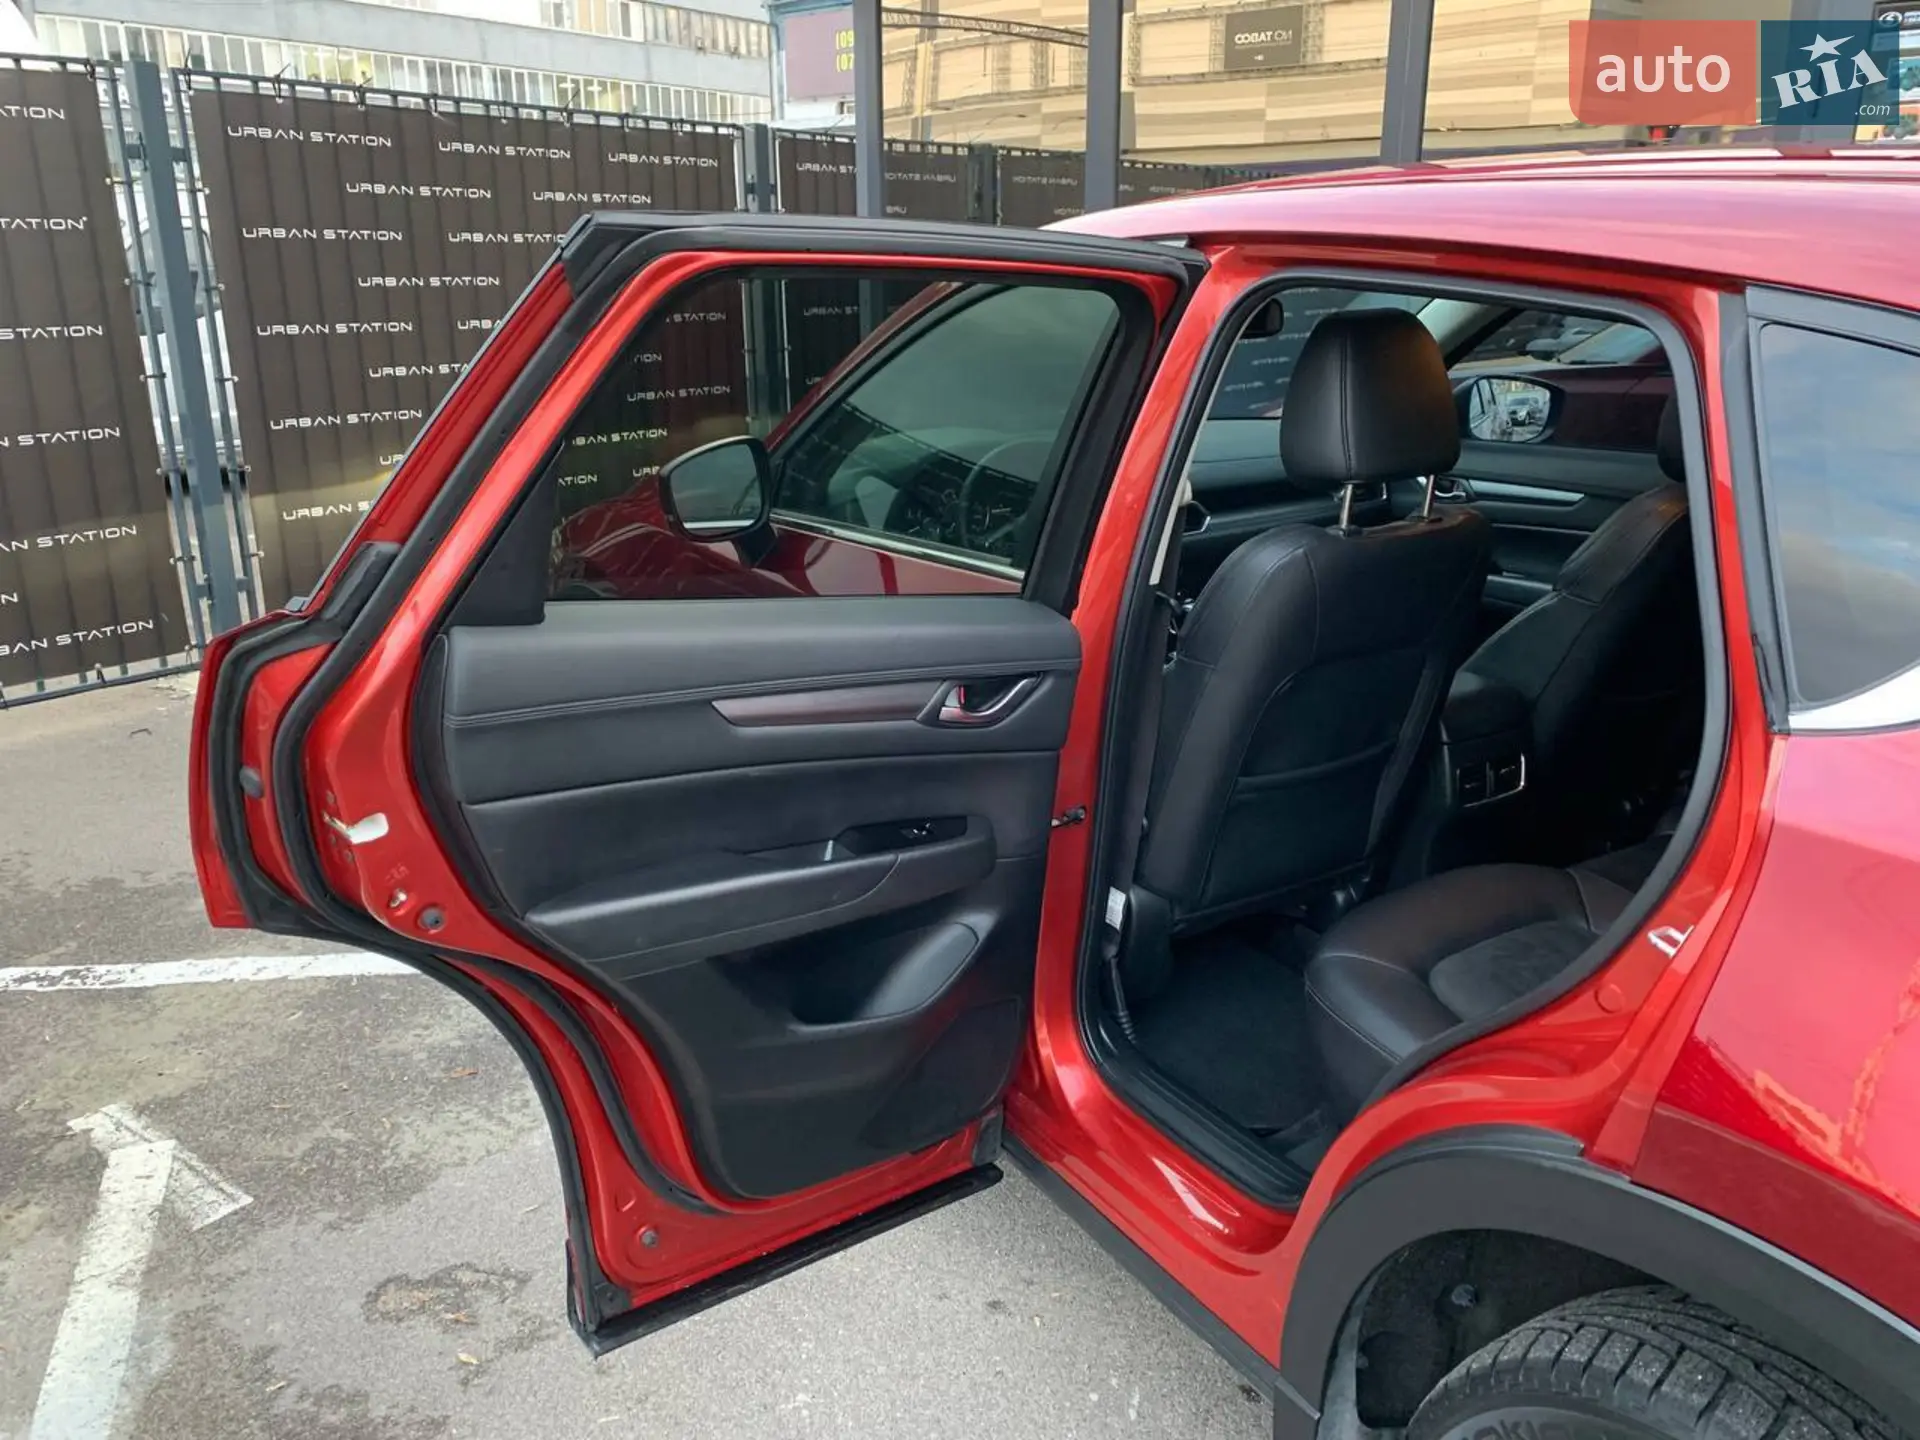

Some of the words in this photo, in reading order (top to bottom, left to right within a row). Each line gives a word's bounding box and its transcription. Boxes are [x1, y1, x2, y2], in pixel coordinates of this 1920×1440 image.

[227, 126, 304, 141] URBAN
[309, 131, 392, 147] STATION
[438, 141, 500, 155] URBAN
[504, 145, 571, 159] STATION
[608, 152, 660, 164] URBAN
[662, 155, 718, 167] STATION
[796, 162, 837, 172] URBAN
[345, 182, 414, 196] URBAN
[419, 185, 492, 199] STATION
[532, 191, 588, 202] URBAN
[591, 193, 652, 204] STATION
[242, 227, 317, 239] URBAN
[322, 228, 403, 241] STATION
[448, 232, 509, 243] URBAN
[357, 276, 424, 287] URBAN
[429, 276, 500, 287] STATION
[672, 312, 727, 323] STATION
[256, 324, 330, 336] URBAN
[335, 321, 413, 334] STATION
[368, 365, 434, 378] URBAN
[626, 390, 676, 402] URBAN
[678, 385, 731, 398] STATION
[270, 415, 341, 430] URBAN
[346, 409, 423, 424] STATION
[17, 427, 121, 446] STATION
[611, 428, 668, 442] STATION
[282, 503, 353, 520] URBAN
[36, 525, 137, 548] STATION
[55, 619, 154, 646] STATION
